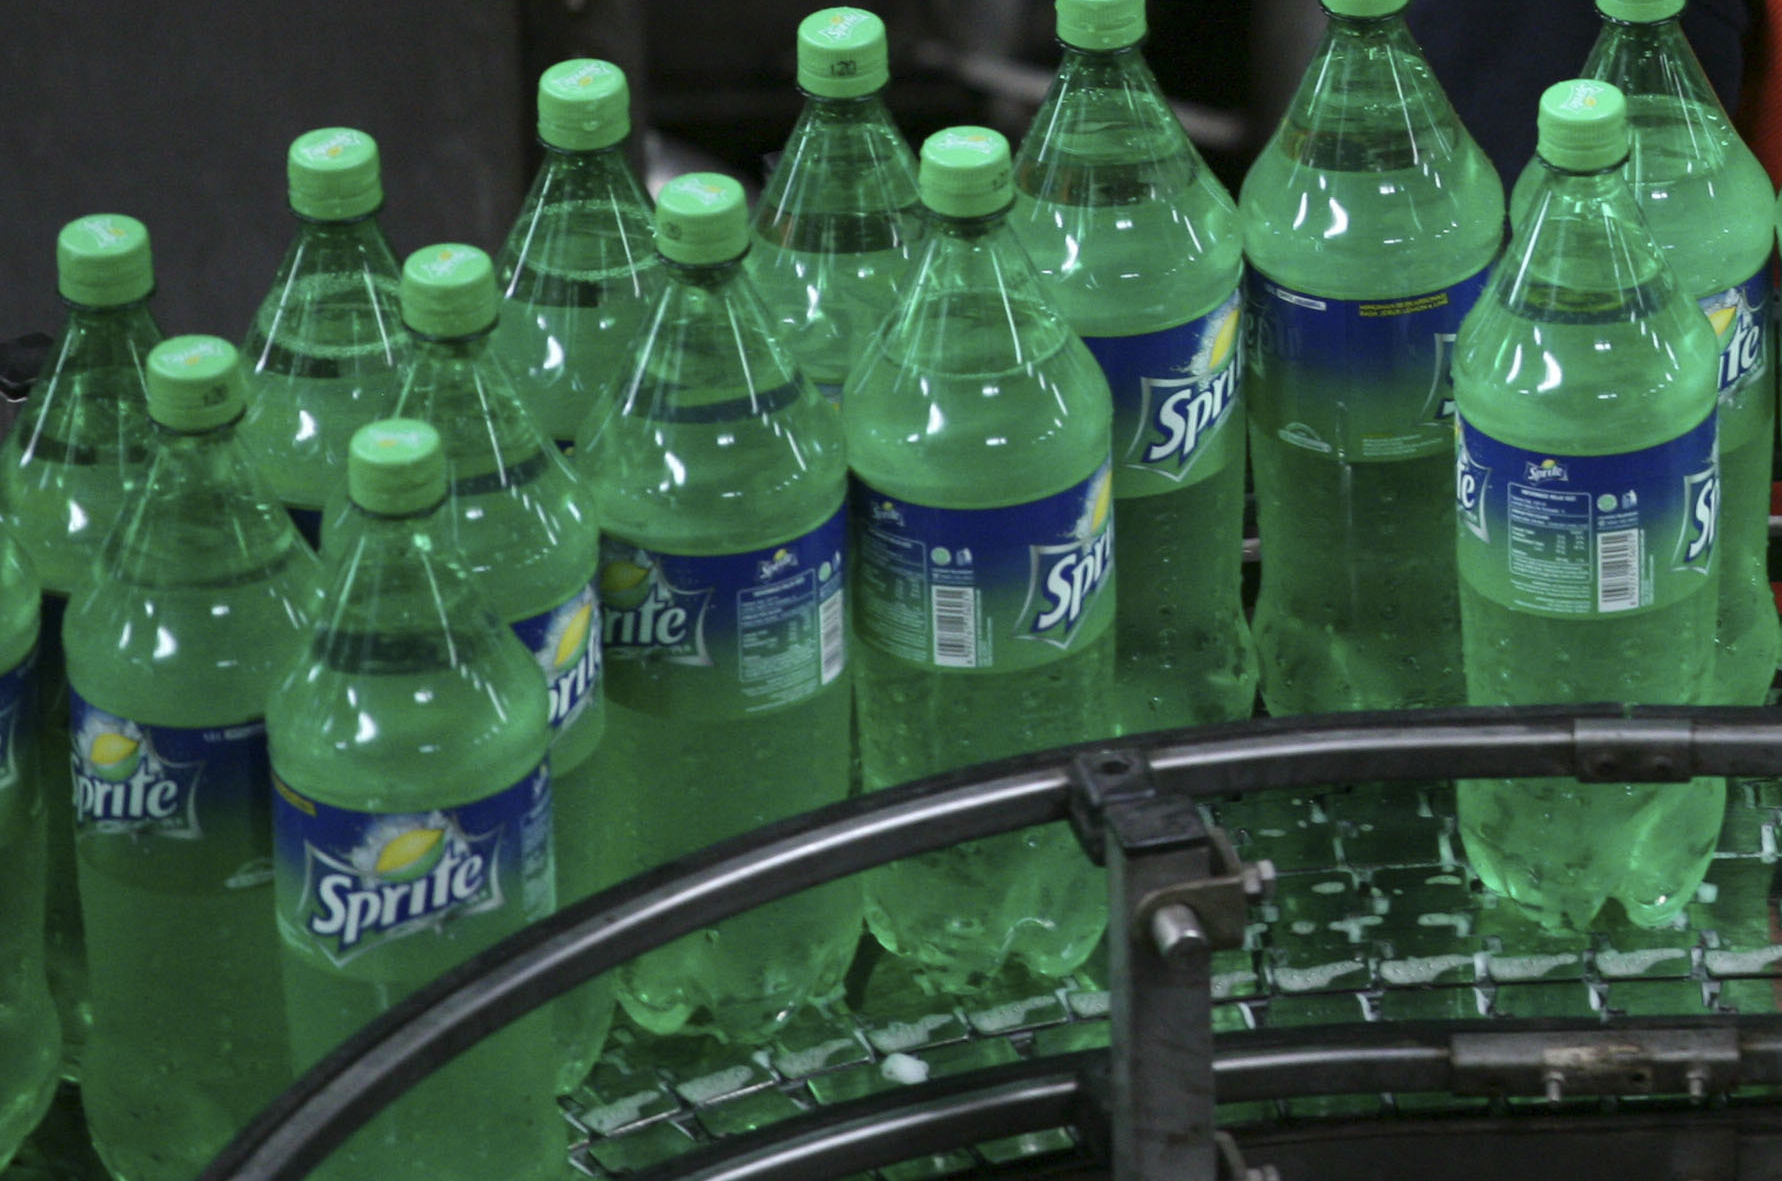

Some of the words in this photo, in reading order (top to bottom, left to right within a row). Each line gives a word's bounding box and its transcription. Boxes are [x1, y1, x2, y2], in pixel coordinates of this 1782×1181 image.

[831, 59, 857, 76] 120
[1718, 321, 1759, 389] ite
[1149, 349, 1240, 460] Spri
[1037, 525, 1111, 629] Spri
[603, 590, 687, 645] rite
[311, 851, 484, 944] Sprite
